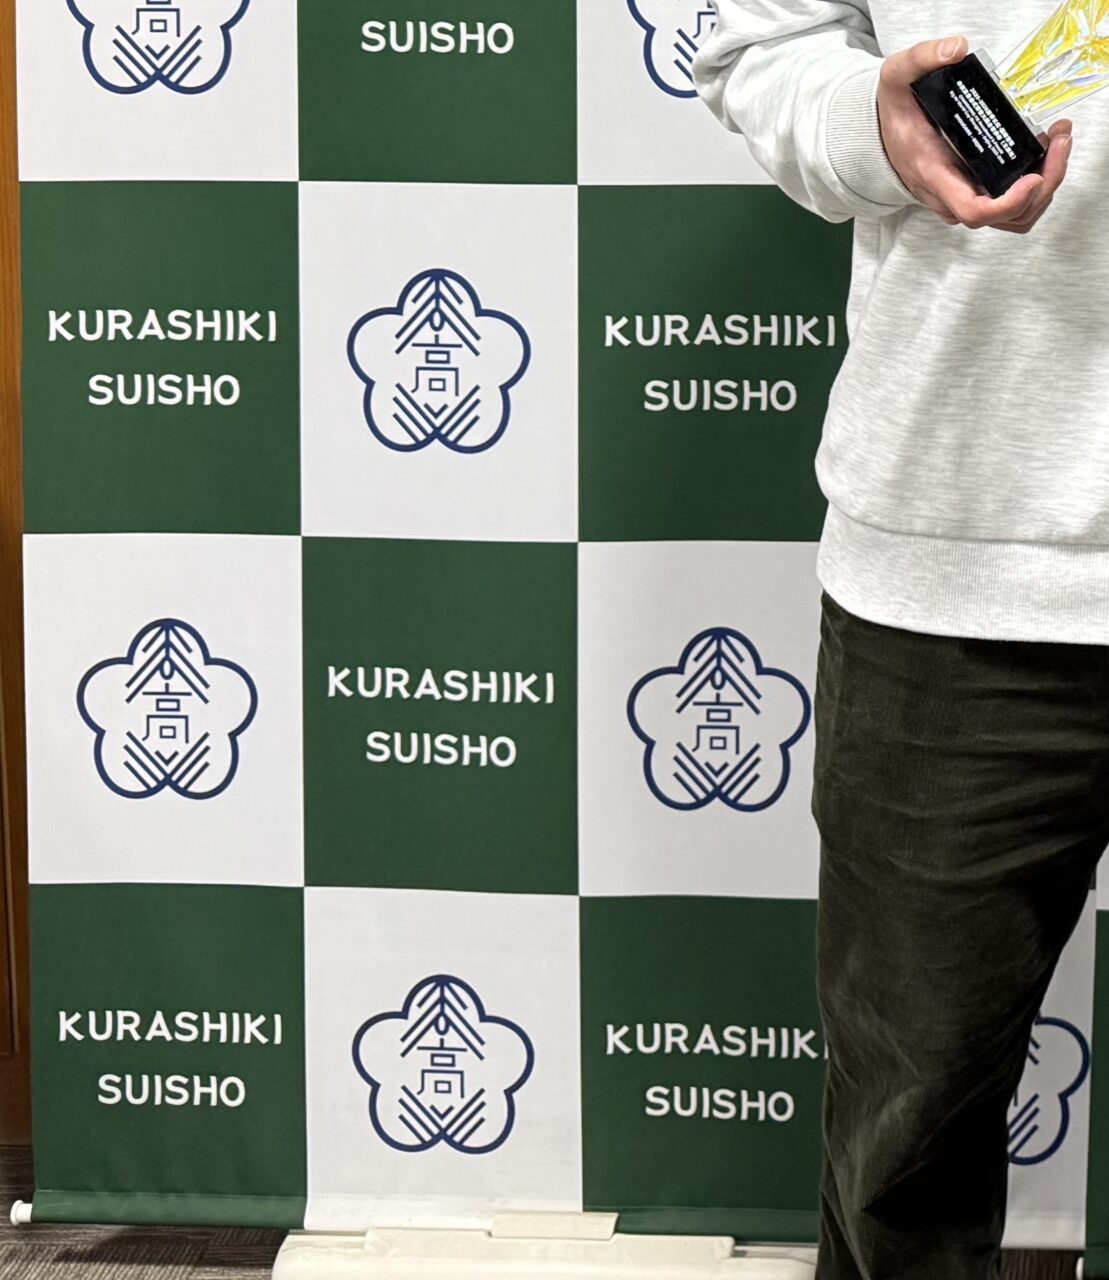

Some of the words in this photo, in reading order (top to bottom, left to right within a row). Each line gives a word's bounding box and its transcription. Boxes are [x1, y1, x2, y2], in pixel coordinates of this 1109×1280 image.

[361, 20, 515, 54] SUISHO
[48, 308, 277, 342] KURASHIKI
[604, 313, 835, 347] KURASHIKI
[88, 373, 241, 406] SUISHO
[644, 379, 797, 412] SUISHO
[327, 665, 554, 704] KURASHIKI
[366, 731, 517, 768] SUISHO
[58, 1010, 282, 1045] KURASHIKI
[97, 1073, 246, 1108] SUISHO
[645, 1085, 794, 1122] SUISHO
